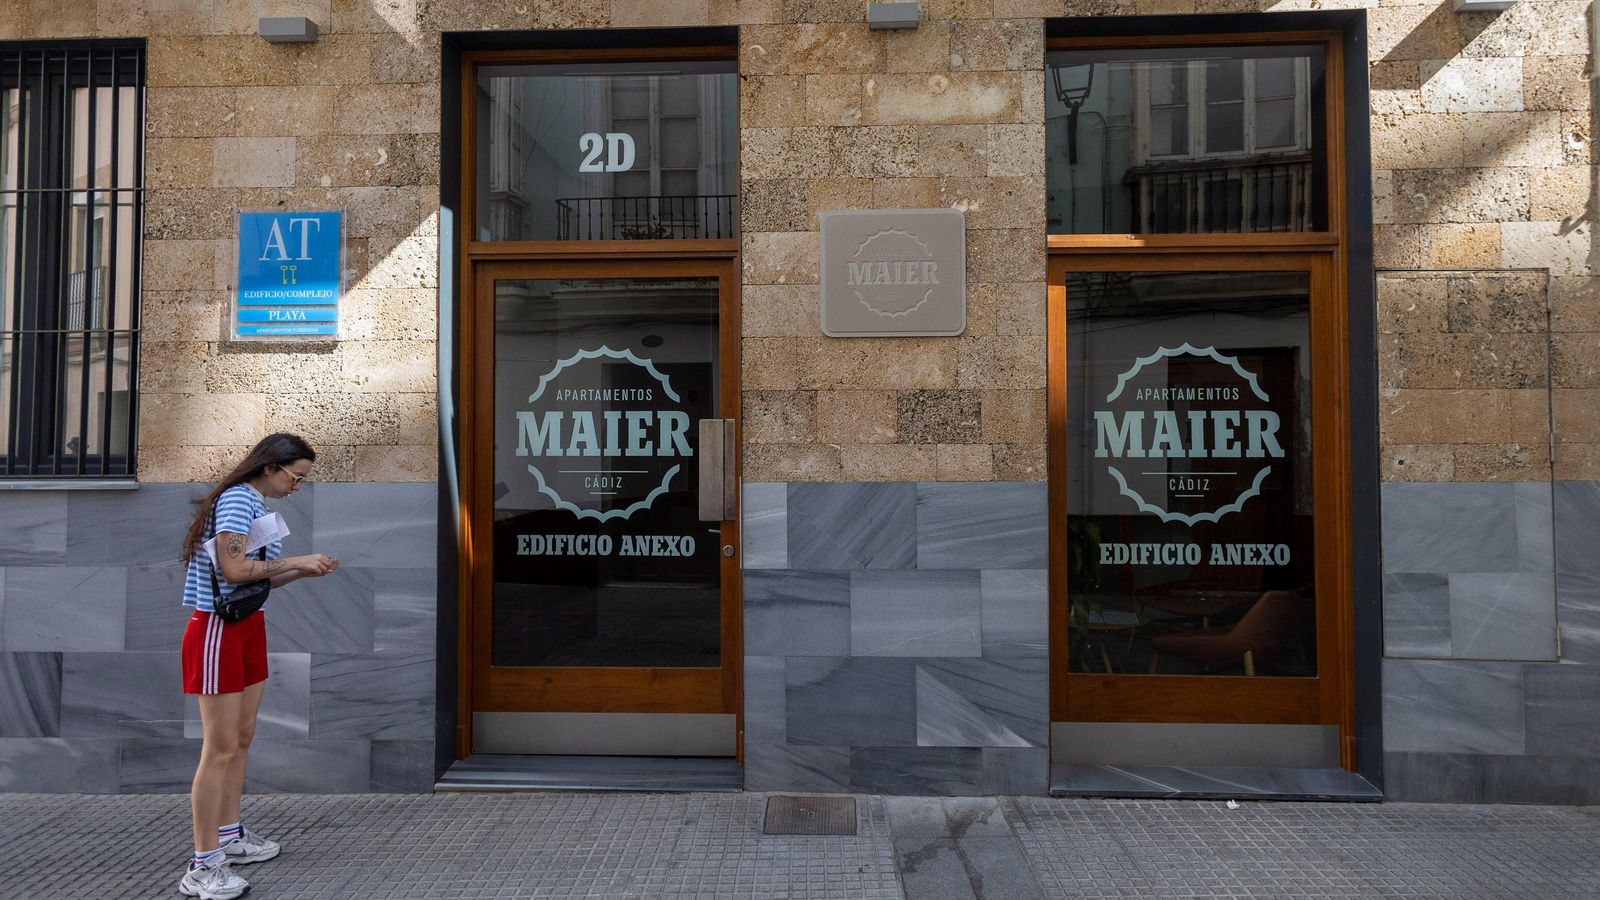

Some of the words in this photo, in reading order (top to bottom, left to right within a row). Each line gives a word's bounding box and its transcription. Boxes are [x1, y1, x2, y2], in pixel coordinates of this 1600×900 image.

[579, 132, 635, 173] 2D
[258, 217, 320, 261] AT
[847, 260, 939, 286] MAIER
[244, 289, 333, 300] EDIFICIO/COMPLEJO
[268, 310, 306, 321] PLAYA
[556, 388, 653, 401] APARTAMENTOS
[1136, 387, 1240, 401] APARTAMENTOS
[515, 410, 694, 457] MAIER
[1093, 410, 1286, 458] MAIER
[584, 474, 623, 489] CÁDIZ
[1169, 476, 1211, 491] CÁDIZ
[517, 534, 613, 556] EDIFICIO
[619, 534, 696, 557] ANEXO
[1099, 543, 1202, 566] EDIFICIO
[1209, 543, 1291, 566] ANEXO
